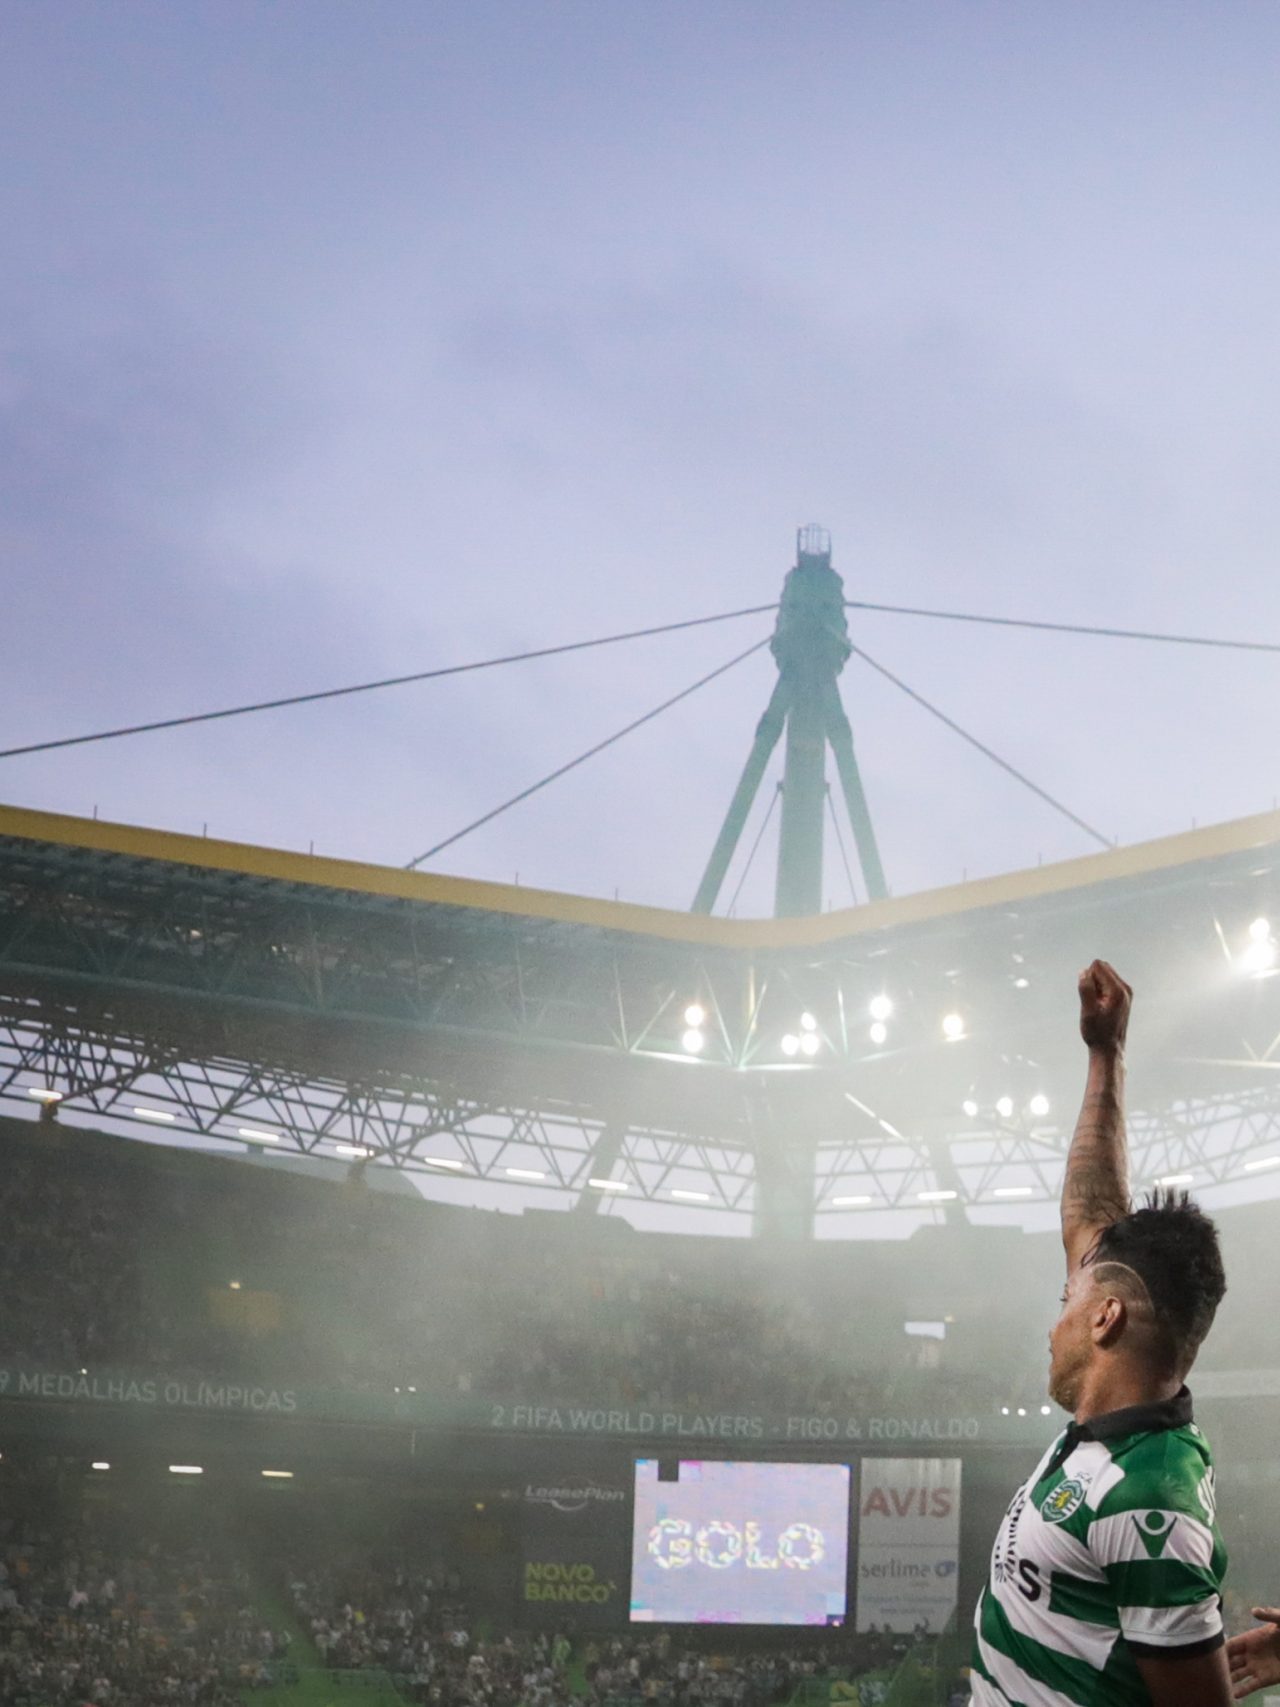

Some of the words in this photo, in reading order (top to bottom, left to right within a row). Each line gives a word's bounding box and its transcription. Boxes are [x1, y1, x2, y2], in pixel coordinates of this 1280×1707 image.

[19, 1371, 157, 1402] MEDALHAS
[165, 1381, 297, 1412] OLÍMPICAS
[491, 1405, 505, 1428] 2
[513, 1405, 563, 1430] FIFA
[569, 1409, 655, 1432] WORLD
[662, 1413, 763, 1438] PLAYERS
[786, 1416, 838, 1439] FIGO
[846, 1417, 862, 1439] &
[868, 1416, 980, 1439] RONALDO
[862, 1487, 952, 1518] AVIS
[648, 1519, 825, 1570] GOLO
[526, 1562, 595, 1582] NOVO
[525, 1582, 609, 1603] BANCO
